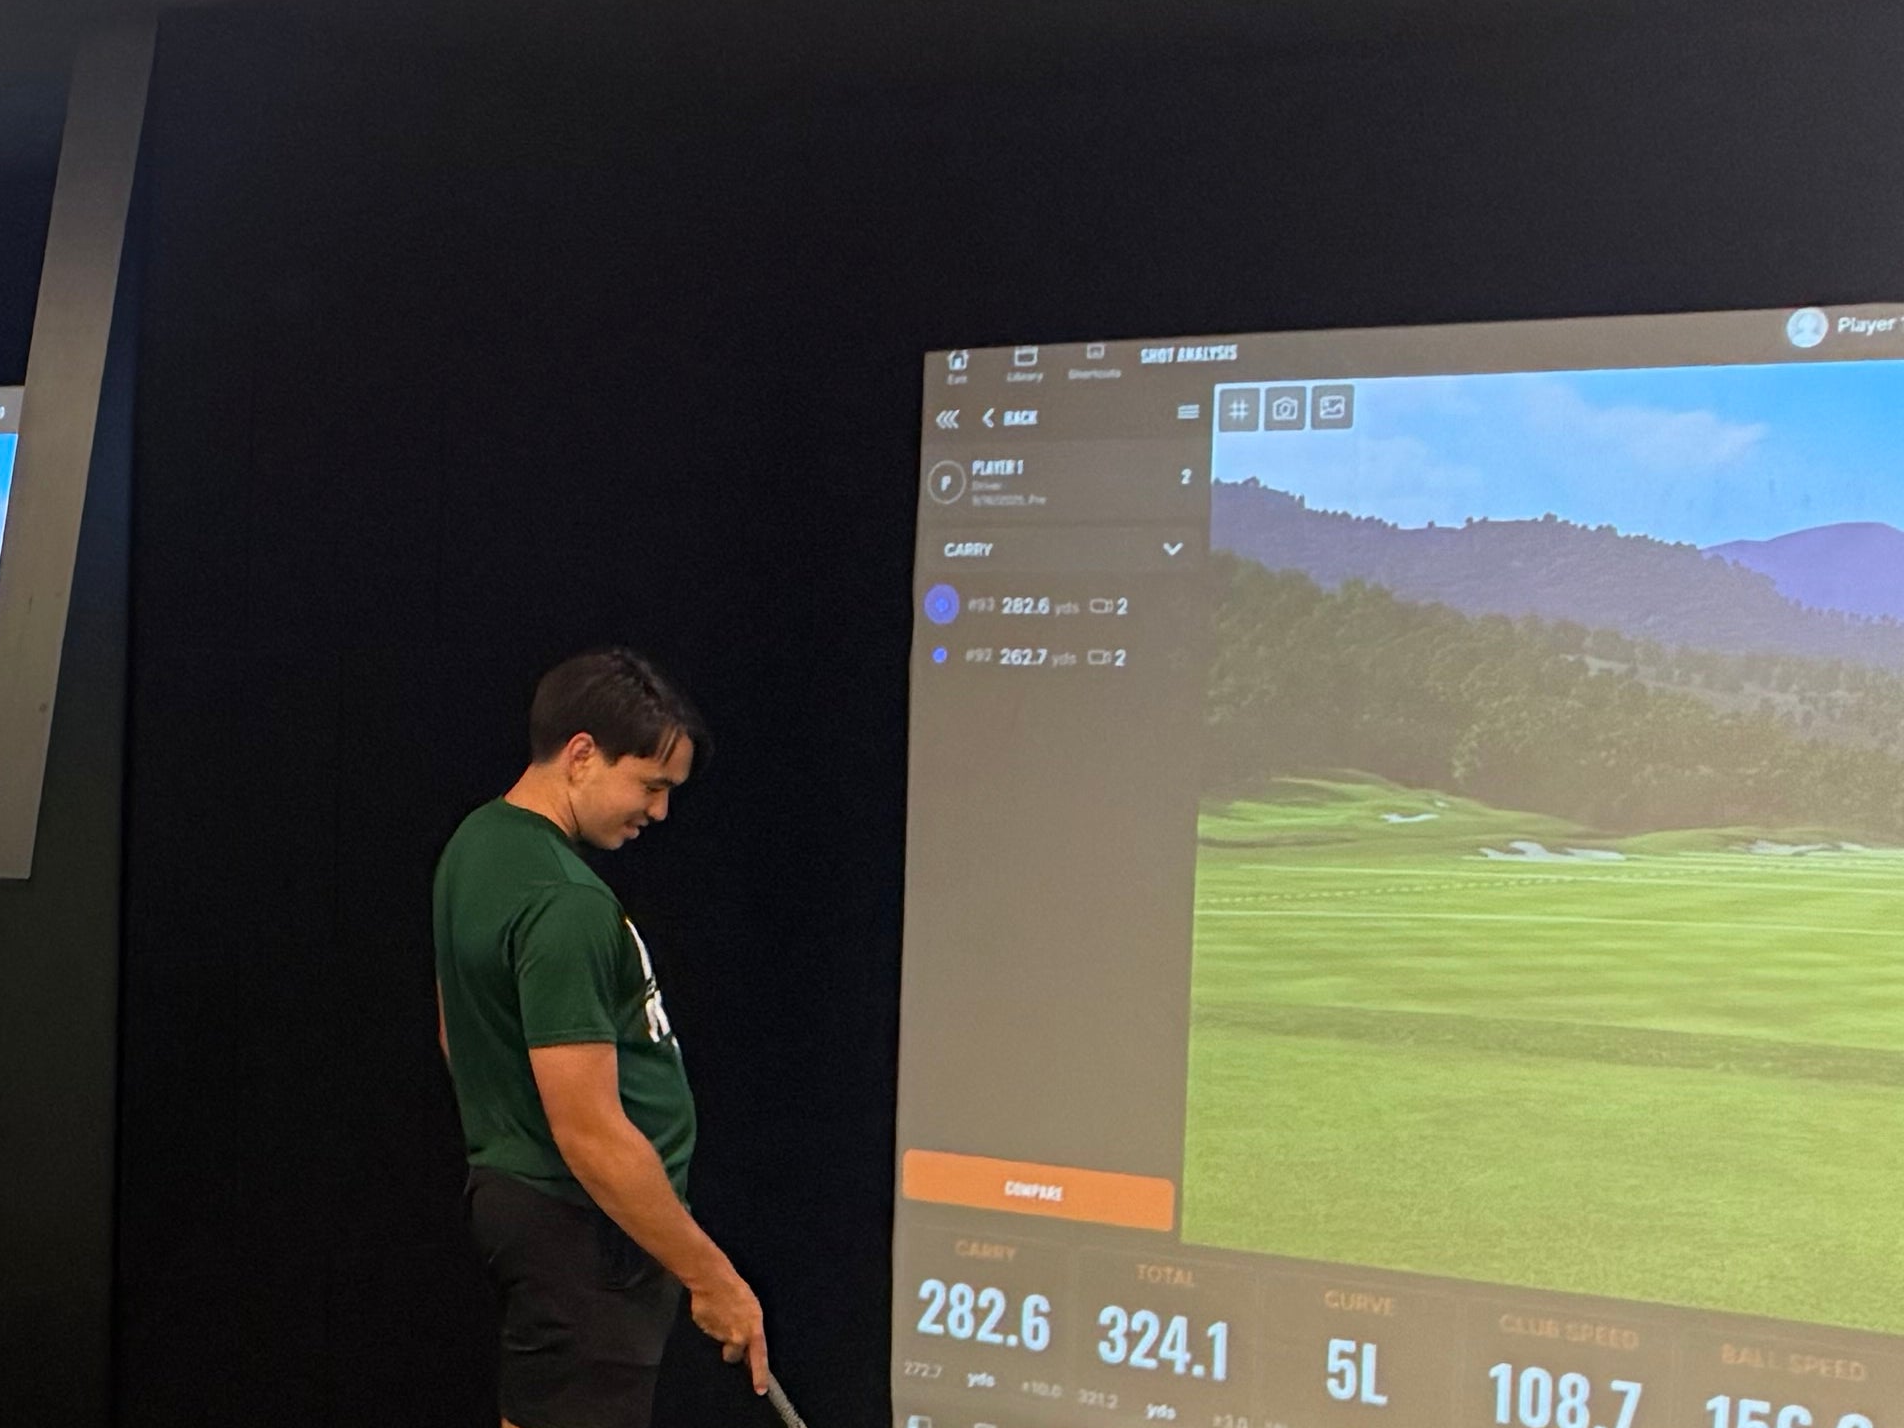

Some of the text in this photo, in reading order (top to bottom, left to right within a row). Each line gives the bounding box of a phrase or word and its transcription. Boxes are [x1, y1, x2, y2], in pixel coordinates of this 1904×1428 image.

[1837, 316, 1897, 336] Player
[1141, 344, 1238, 363] SHOT ANALYSIS
[1003, 410, 1038, 426] BACK
[971, 459, 1024, 475] PLAYER 1
[1180, 468, 1192, 485] 2
[944, 542, 993, 557] CARRY
[1002, 597, 1050, 615] 282.6
[1116, 598, 1128, 615] 2
[1000, 648, 1047, 665] 262.7
[1114, 649, 1127, 667] 2
[1003, 1178, 1065, 1203] COMPARE
[955, 1239, 1018, 1262] CARRY
[1136, 1263, 1195, 1288] TOTAL
[916, 1278, 1052, 1352] 282.6
[1498, 1314, 1640, 1351] CLUB SPEED
[1097, 1304, 1229, 1382] 324.1
[1721, 1342, 1867, 1382] BALL SPEED
[966, 1370, 996, 1389] yds
[1326, 1337, 1389, 1407] 5L
[1145, 1402, 1177, 1421] yds
